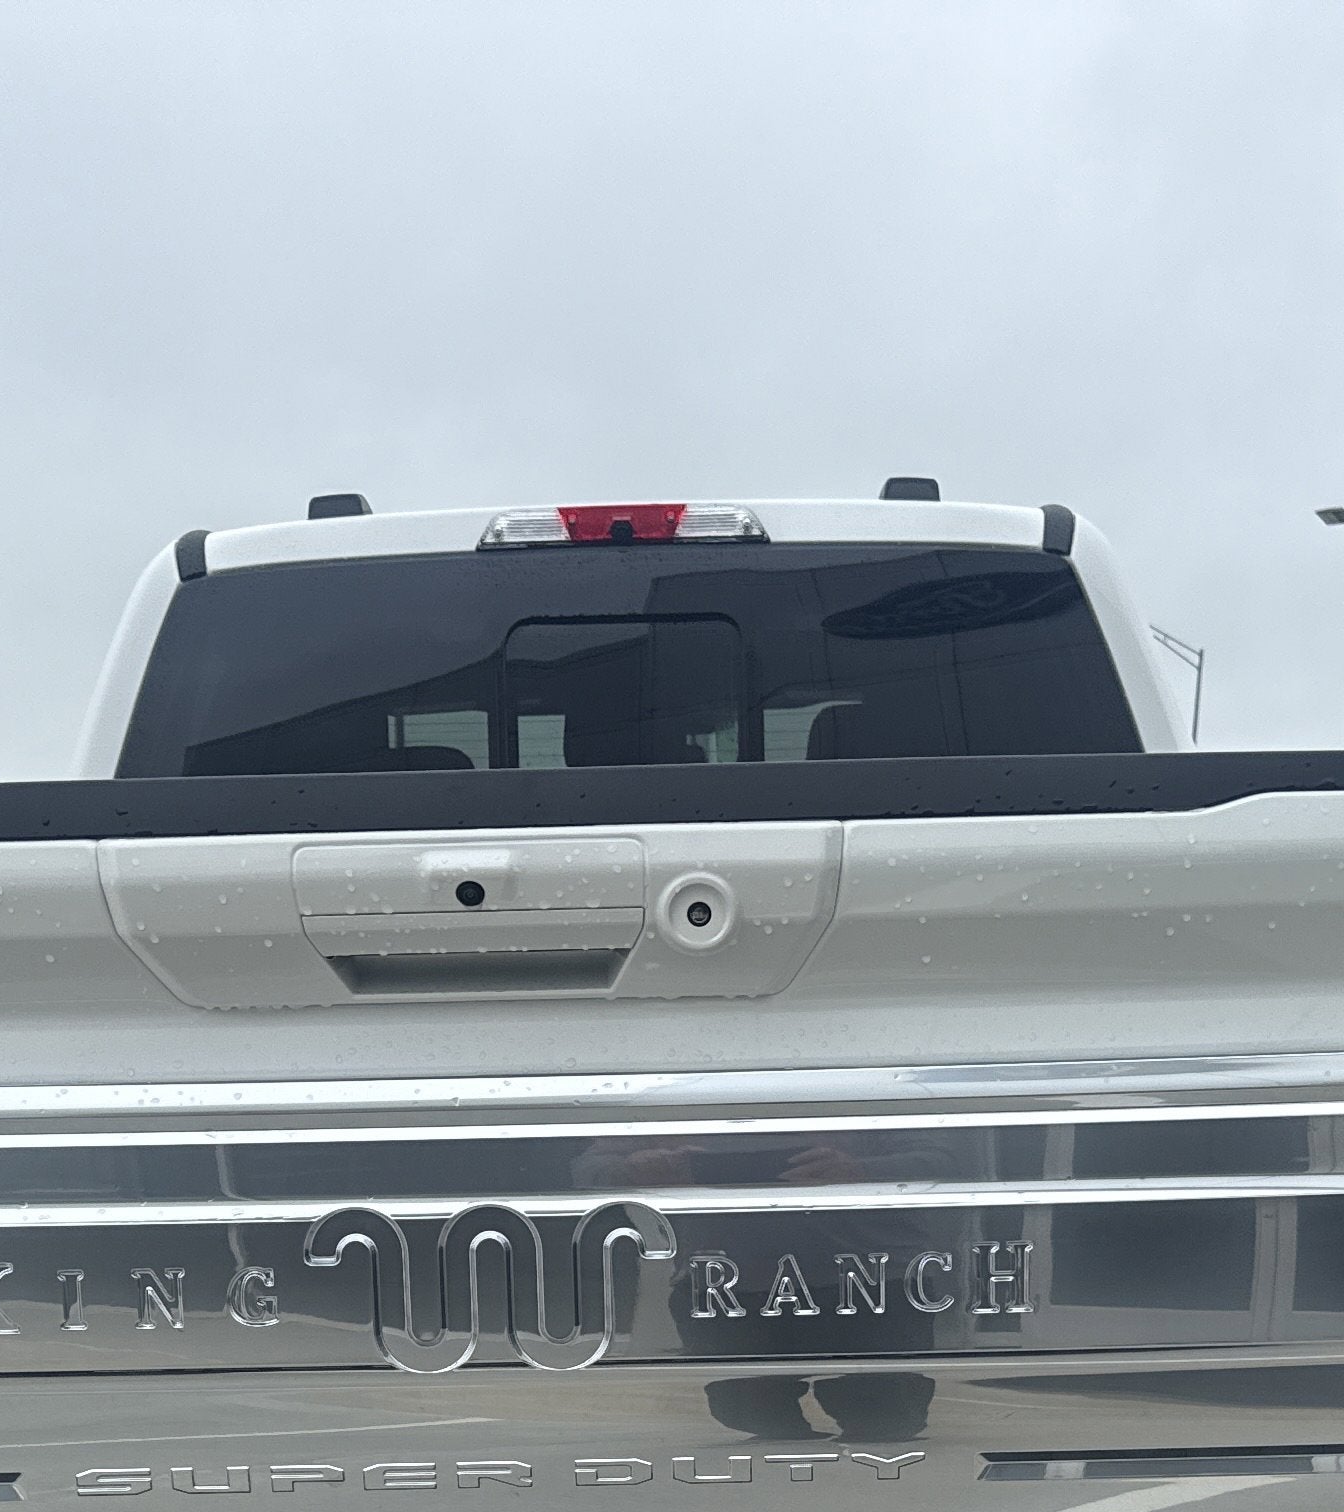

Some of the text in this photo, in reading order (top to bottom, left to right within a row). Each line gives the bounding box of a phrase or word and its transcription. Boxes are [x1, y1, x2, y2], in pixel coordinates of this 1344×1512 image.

[689, 1239, 1035, 1318] RANCH
[74, 1451, 926, 1496] SUPER DUTY
